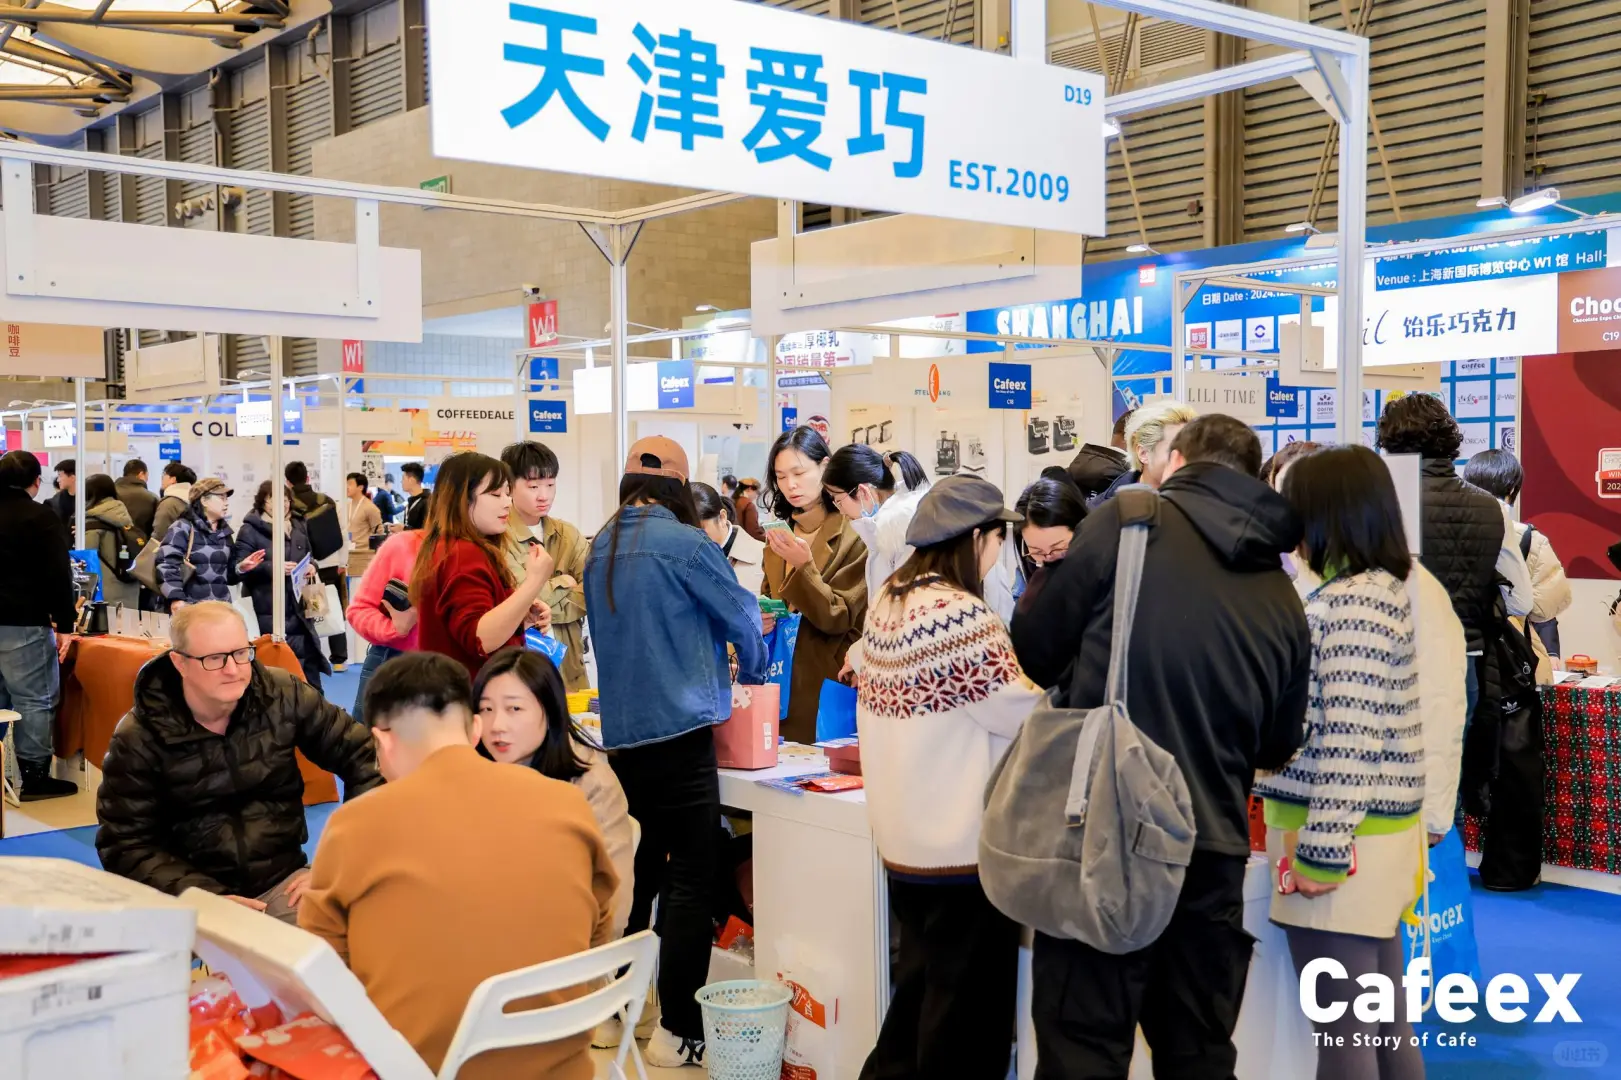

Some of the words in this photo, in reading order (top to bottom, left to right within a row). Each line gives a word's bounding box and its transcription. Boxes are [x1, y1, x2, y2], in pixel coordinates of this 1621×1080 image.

[500, 2, 927, 178] 天津爱巧
[1064, 85, 1092, 106] D19
[949, 160, 1070, 203] EST.2009
[1377, 272, 1410, 286] Venue
[1418, 258, 1531, 283] 上海新国际博览中心
[1533, 256, 1551, 268] W1
[1555, 253, 1569, 267] 馆
[1202, 291, 1221, 306] 日期
[1223, 291, 1244, 303] Date
[532, 315, 555, 344] W1
[997, 296, 1143, 346] SHANGHAI
[1403, 307, 1517, 339] 饴乐巧克力
[8, 324, 20, 357] 咖啡豆
[1602, 331, 1620, 341] C19
[344, 344, 363, 367] W1
[994, 377, 1026, 390] Cafeex
[1188, 387, 1217, 403] LILI
[1223, 389, 1256, 404] TIME
[1269, 390, 1294, 401] Cafeex
[533, 410, 562, 420] Cafeex
